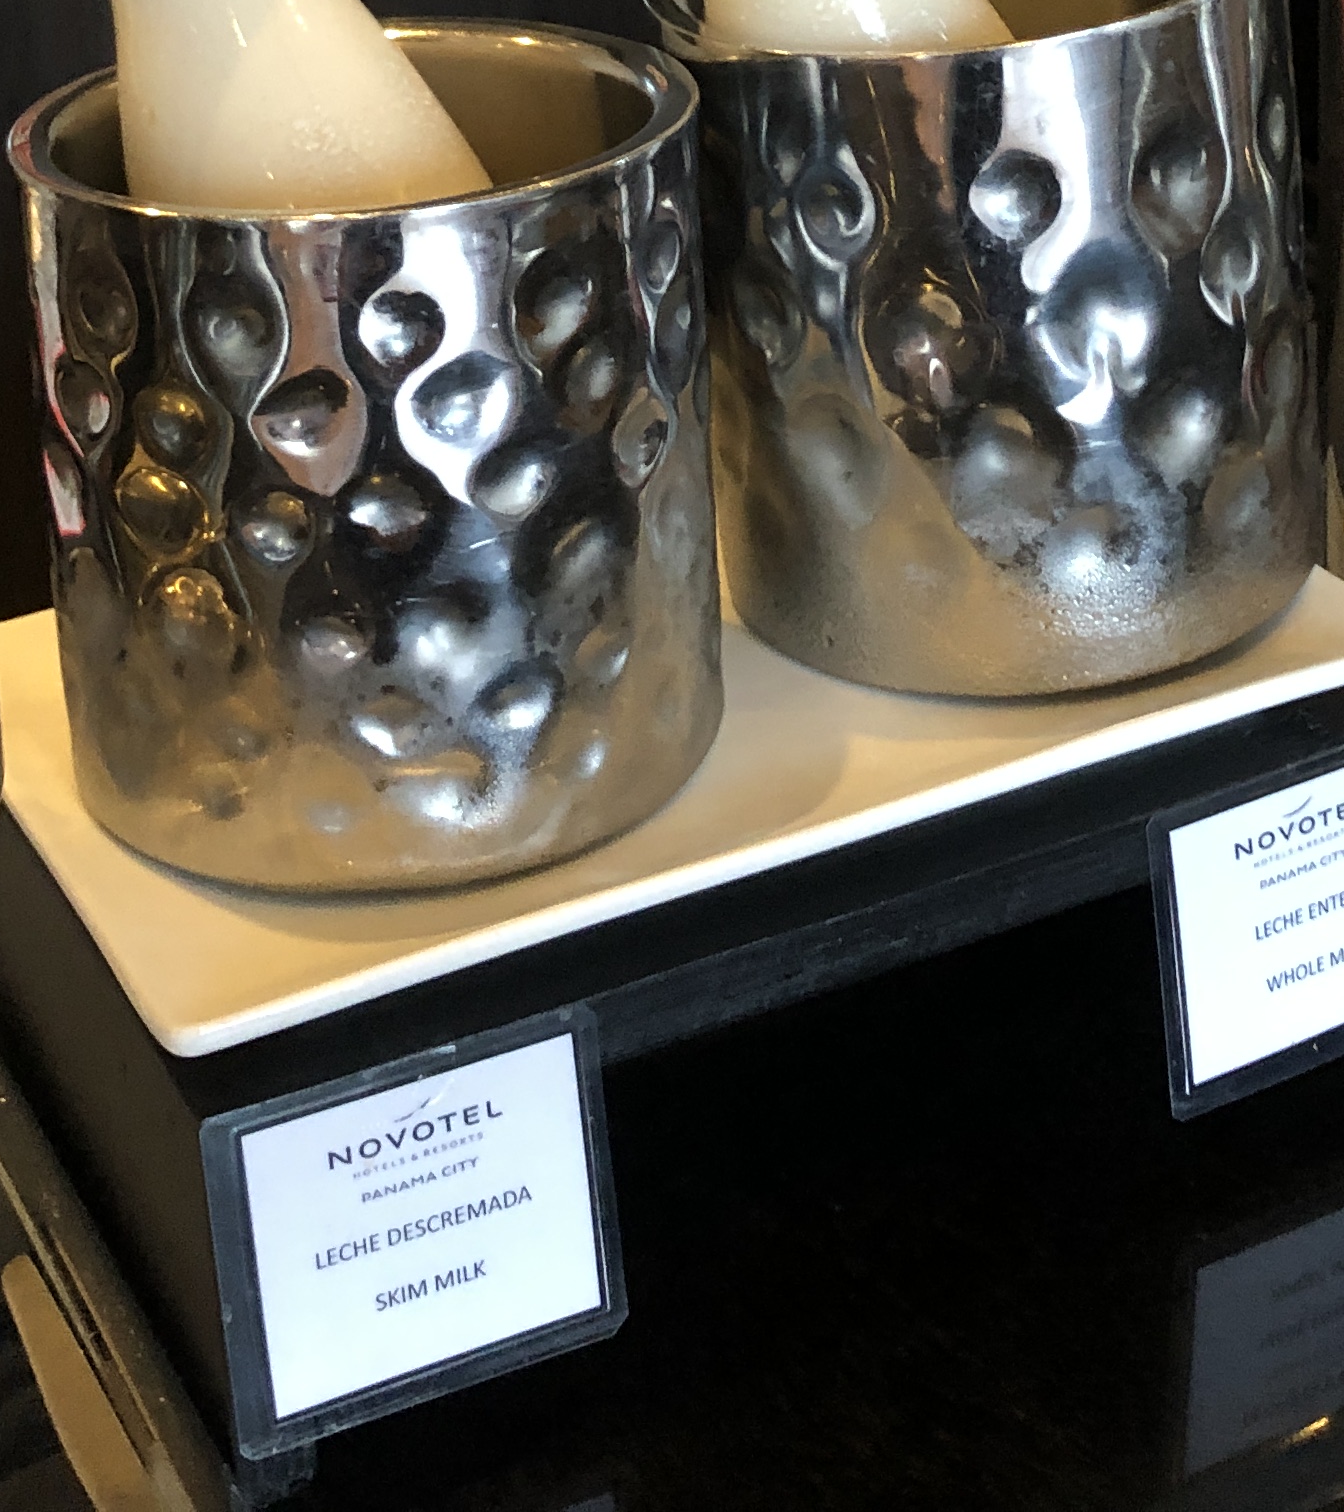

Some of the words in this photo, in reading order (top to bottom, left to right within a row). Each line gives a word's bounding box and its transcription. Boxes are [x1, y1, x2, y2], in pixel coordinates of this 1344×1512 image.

[1260, 861, 1316, 889] PANAMA
[1255, 909, 1303, 940] LECHE
[1266, 956, 1324, 992] WHOLE
[328, 1100, 503, 1170] NOVOTEL
[353, 1157, 407, 1179] HOTELS
[412, 1154, 418, 1162] &
[424, 1132, 484, 1157] RESORTS
[361, 1172, 437, 1202] PANAMA
[442, 1157, 479, 1176] CITY
[315, 1234, 381, 1270] LECHE
[388, 1186, 532, 1246] DESCREMADA
[376, 1279, 428, 1311] SKIM
[435, 1260, 487, 1291] MILK
